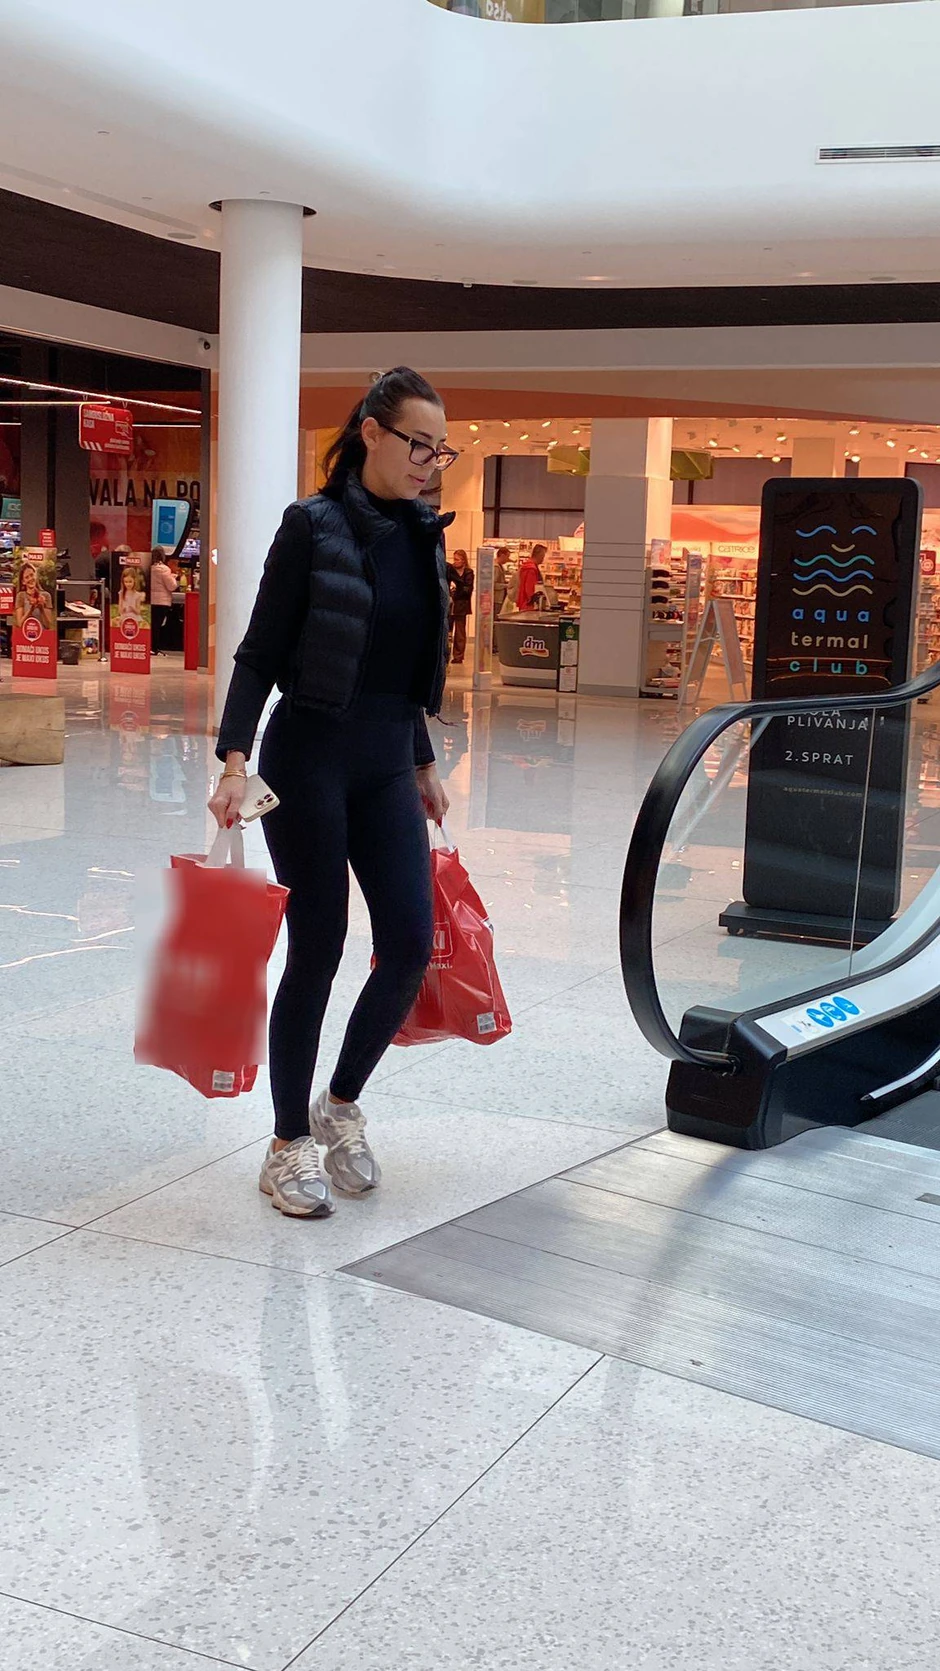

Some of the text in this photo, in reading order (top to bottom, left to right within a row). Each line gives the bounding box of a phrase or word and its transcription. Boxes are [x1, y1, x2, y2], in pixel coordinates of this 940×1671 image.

[144, 479, 168, 507] NA
[791, 607, 870, 624] aqua
[523, 636, 545, 651] dm
[791, 631, 869, 649] termal
[789, 657, 869, 675] club
[787, 716, 868, 731] PLIVANJA
